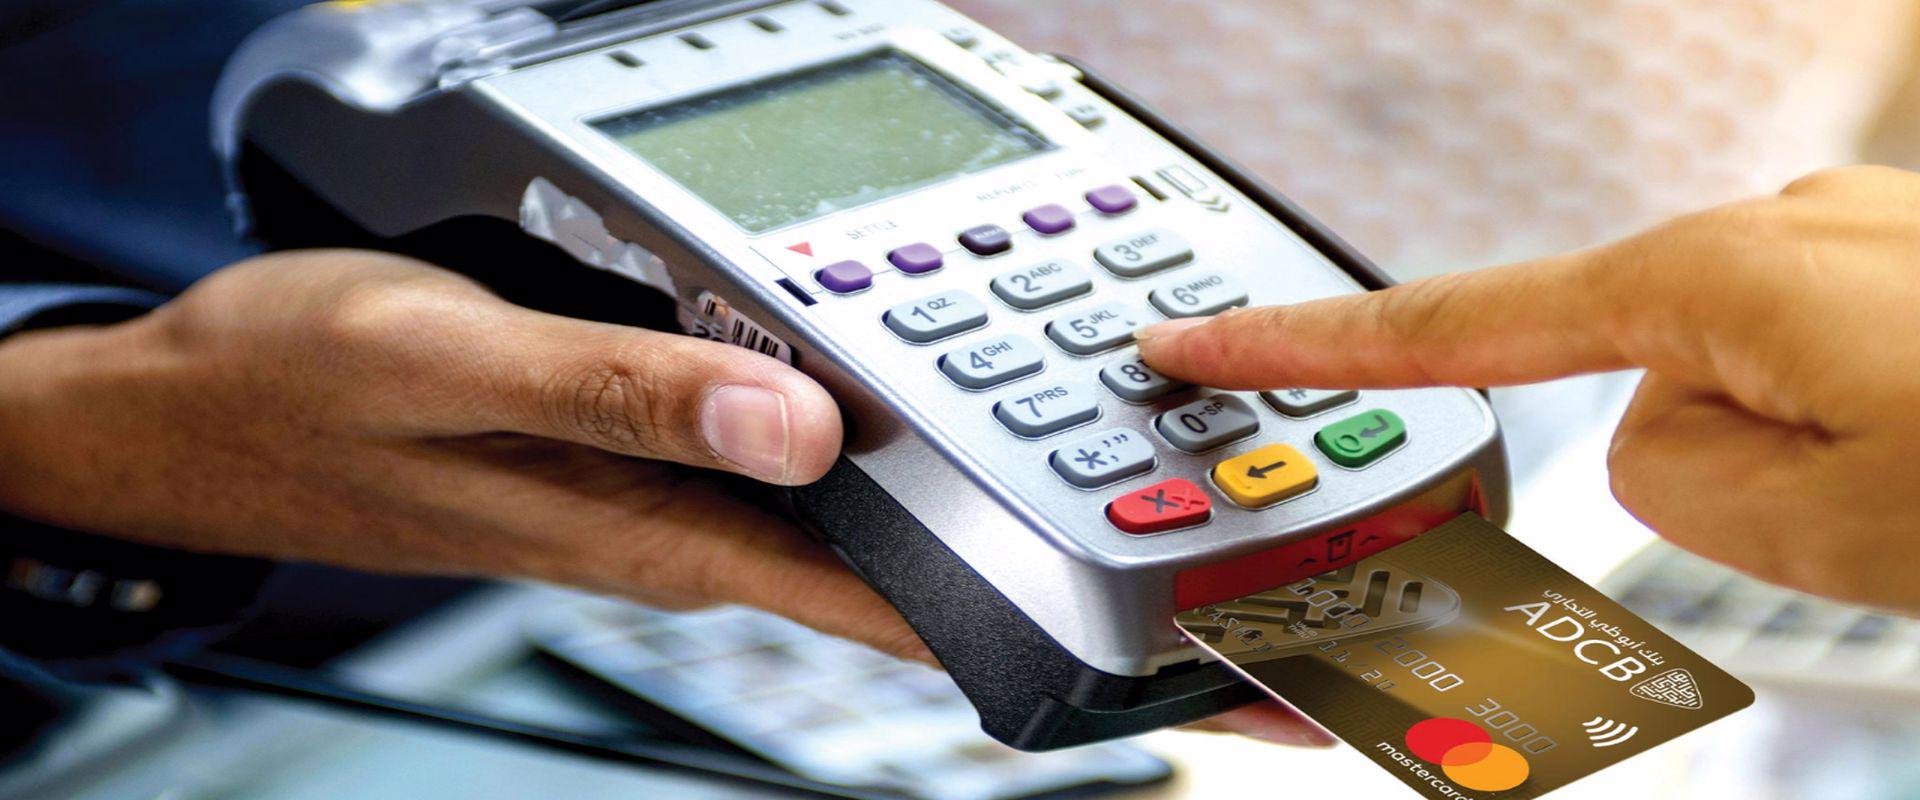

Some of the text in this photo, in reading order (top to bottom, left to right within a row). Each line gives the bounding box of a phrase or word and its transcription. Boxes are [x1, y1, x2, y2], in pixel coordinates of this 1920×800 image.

[846, 217, 899, 240] SETTLE
[1113, 234, 1159, 262] 3 DEF
[1010, 262, 1062, 293] 2 ABC
[1172, 275, 1223, 306] 6 MNO
[911, 306, 937, 323] 1
[1069, 309, 1119, 339] 5 JKL
[969, 340, 1014, 370] 4 GHI
[1120, 364, 1152, 383] 8
[1015, 386, 1069, 418] 7 PRS
[1180, 412, 1208, 434] 0
[1543, 589, 1597, 620] التجاري
[1503, 601, 1647, 682] ADCB
[1287, 577, 1558, 755] 1000 2000 3000
[1638, 649, 1666, 666] بنك
